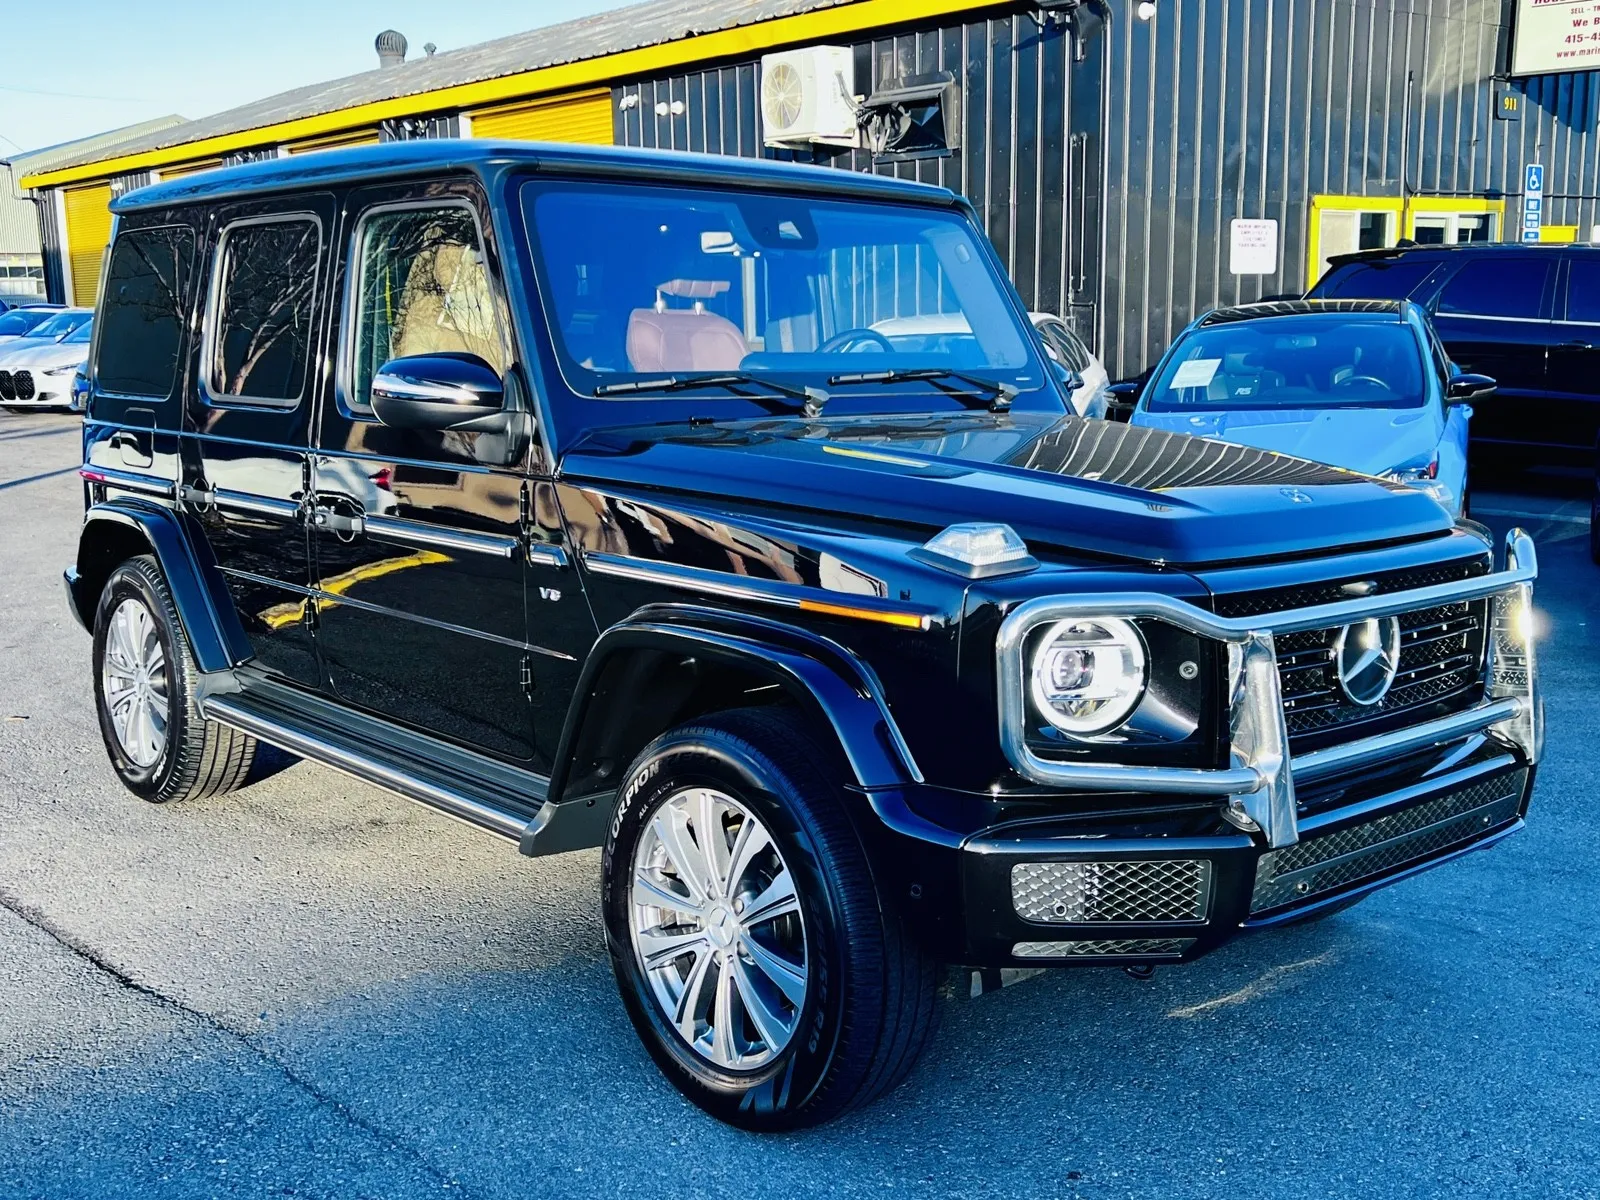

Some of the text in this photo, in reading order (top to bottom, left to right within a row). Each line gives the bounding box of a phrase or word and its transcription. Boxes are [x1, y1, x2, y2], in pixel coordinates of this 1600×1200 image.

[1572, 18, 1588, 27] We
[1565, 32, 1600, 43] 415-4
[1504, 97, 1517, 111] 911
